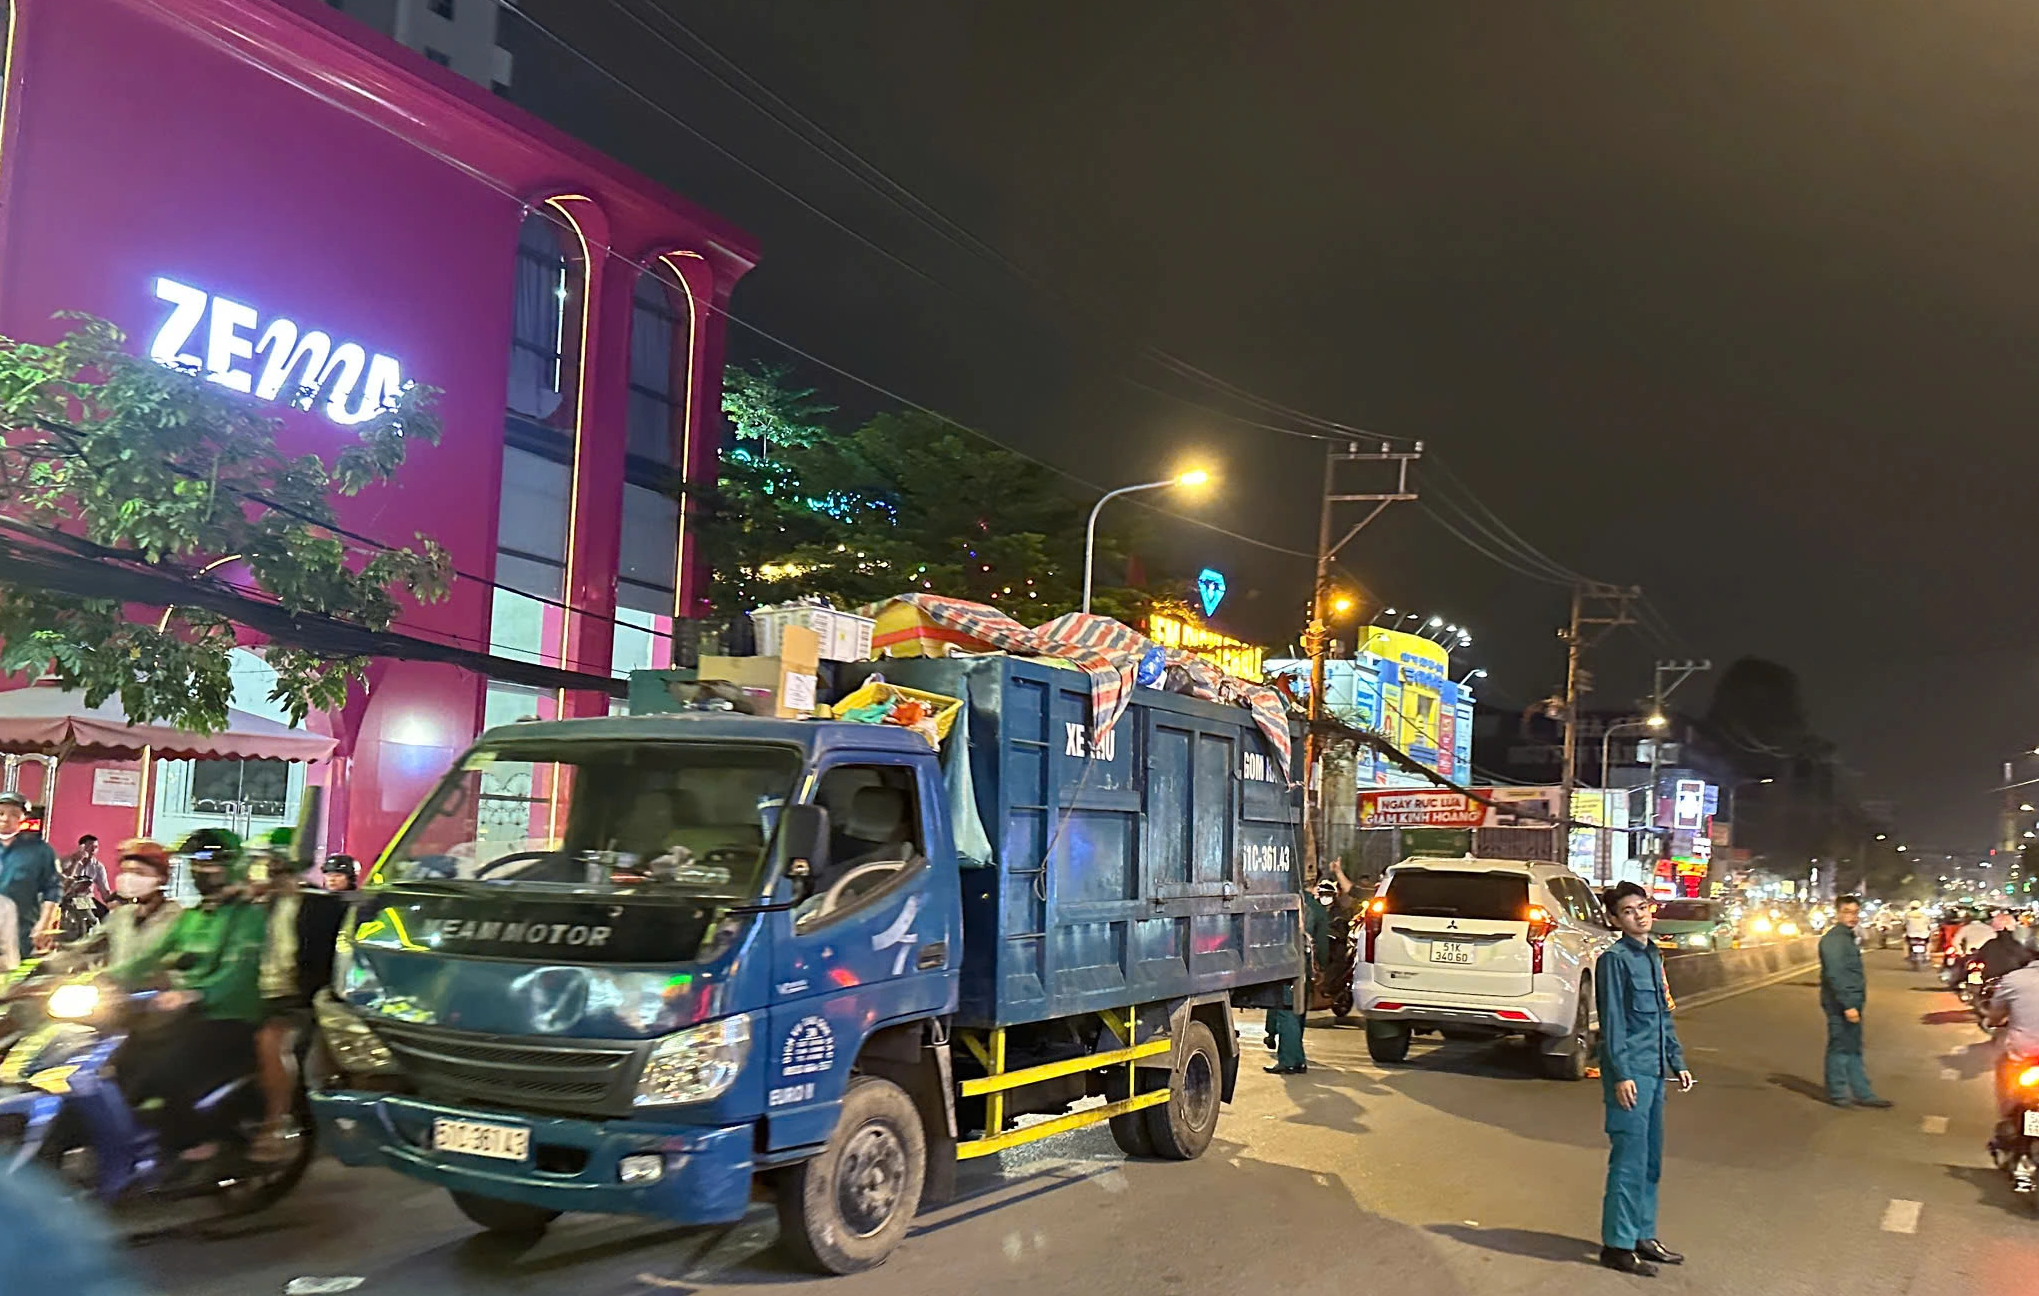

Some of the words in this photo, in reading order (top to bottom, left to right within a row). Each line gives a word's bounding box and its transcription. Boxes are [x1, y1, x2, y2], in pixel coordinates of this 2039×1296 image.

[1065, 722, 1085, 757] XE
[1243, 751, 1265, 781] GOM
[502, 921, 613, 947] MOTOR
[1443, 943, 1461, 952] 51K
